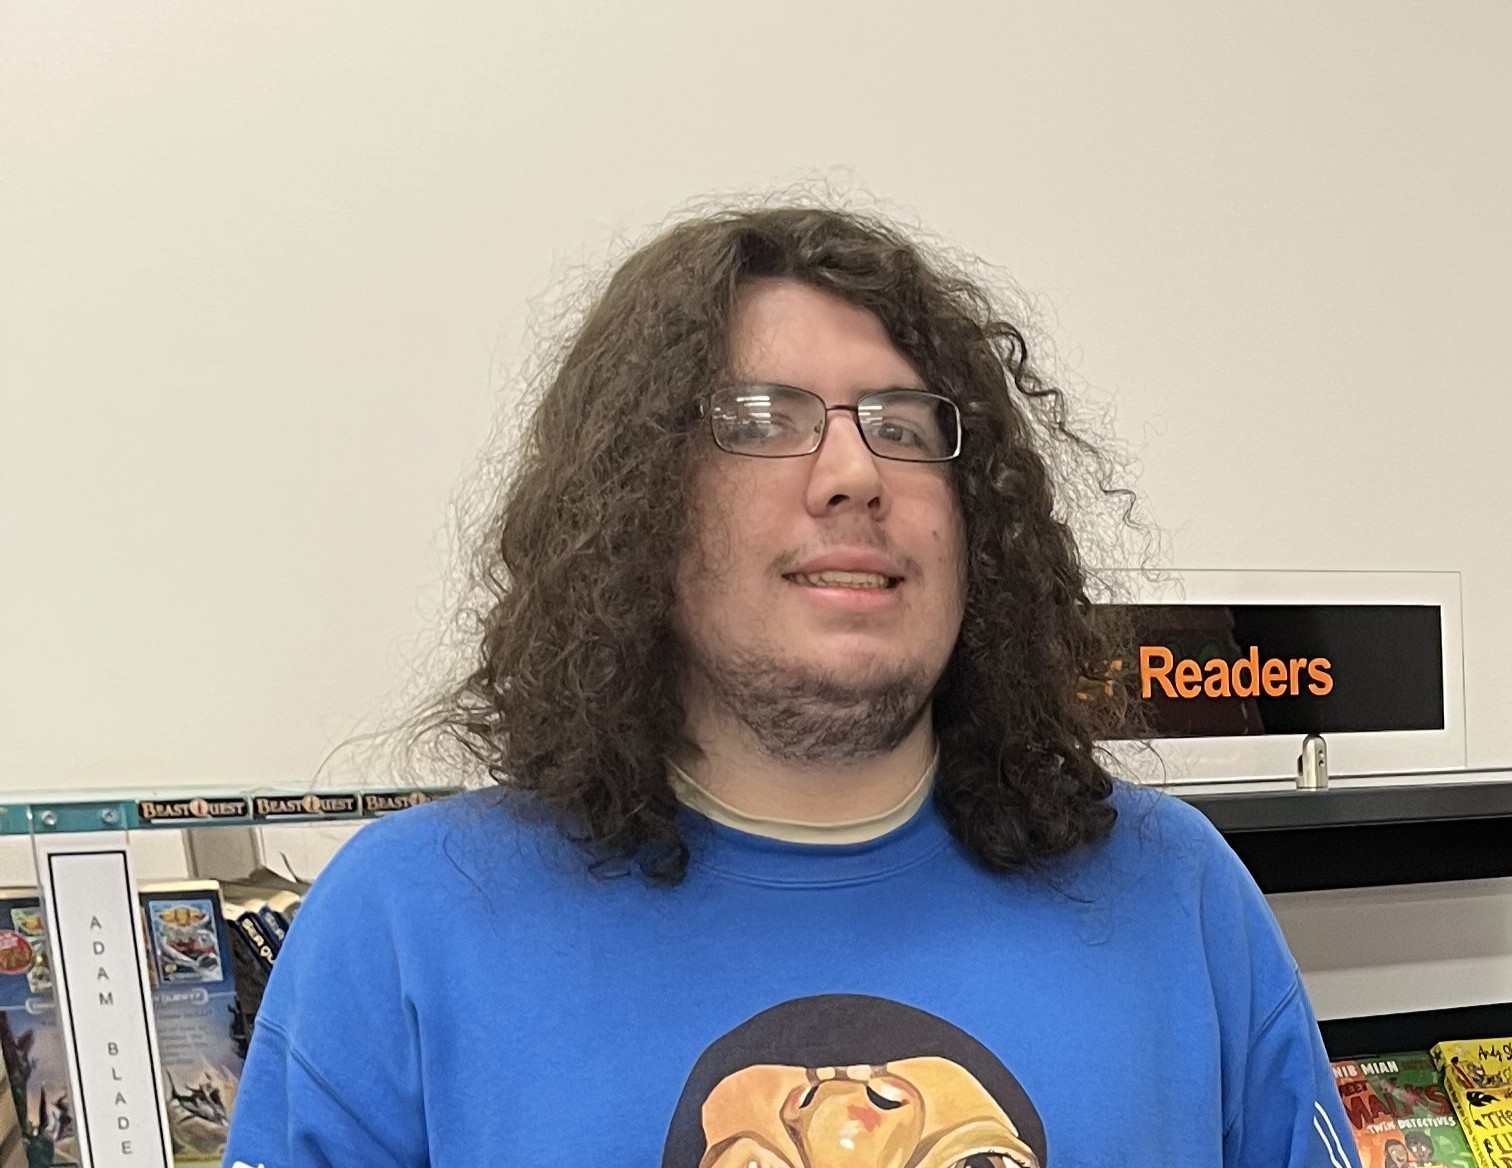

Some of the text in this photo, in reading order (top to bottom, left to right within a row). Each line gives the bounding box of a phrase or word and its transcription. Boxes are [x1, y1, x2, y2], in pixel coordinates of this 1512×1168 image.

[1140, 646, 1333, 698] Readers
[90, 914, 134, 1156] ADAM BLADE
[1478, 1045, 1502, 1062] Andy
[1360, 1060, 1399, 1076] MIAN
[1367, 1116, 1456, 1134] TWIN DETECTIVES
